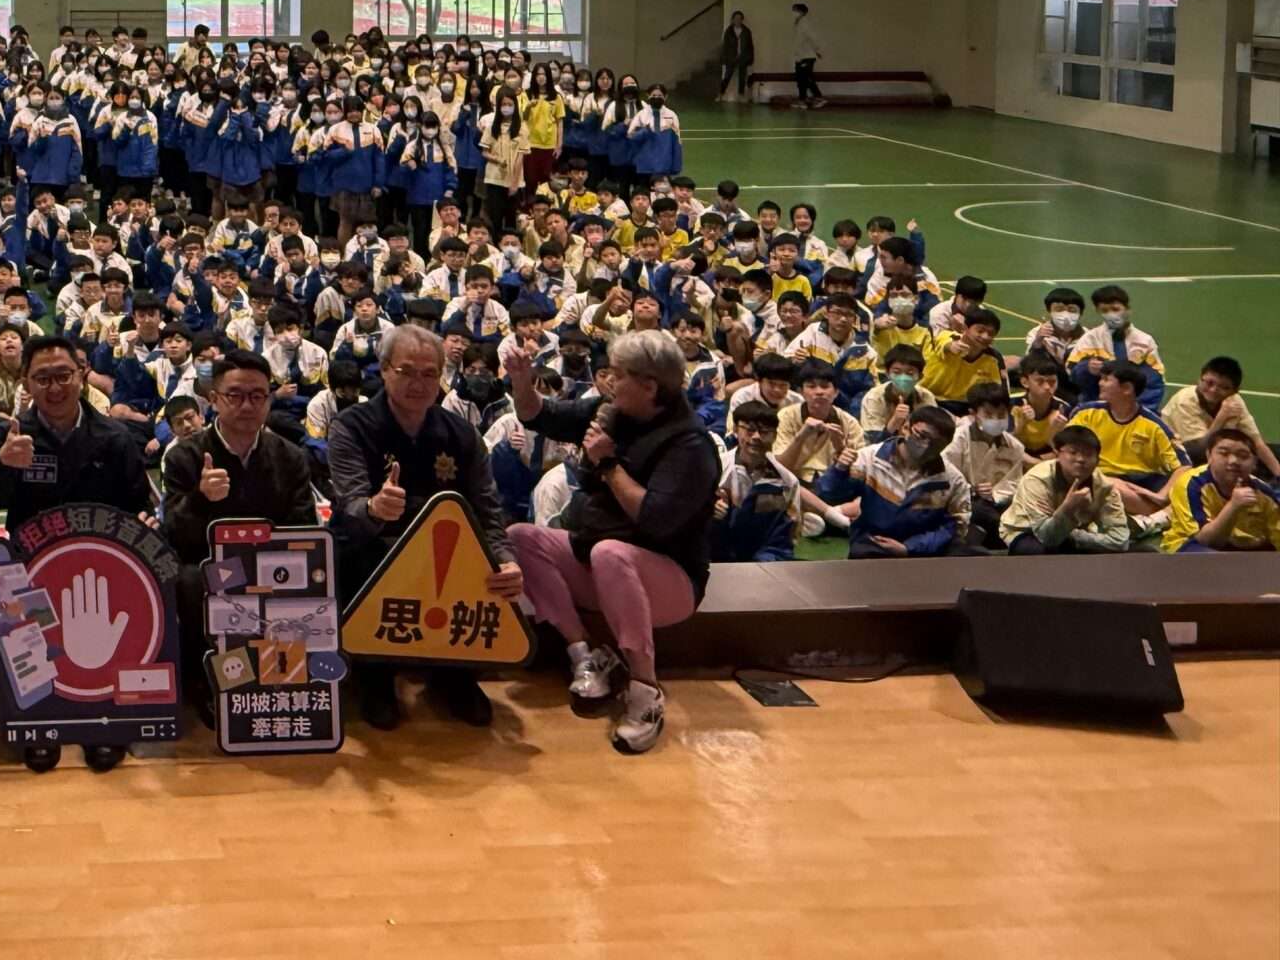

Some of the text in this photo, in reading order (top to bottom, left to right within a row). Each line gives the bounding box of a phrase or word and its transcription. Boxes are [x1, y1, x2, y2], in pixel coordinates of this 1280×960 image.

[231, 691, 331, 714] 別被演算法
[252, 716, 313, 739] 牽著走
